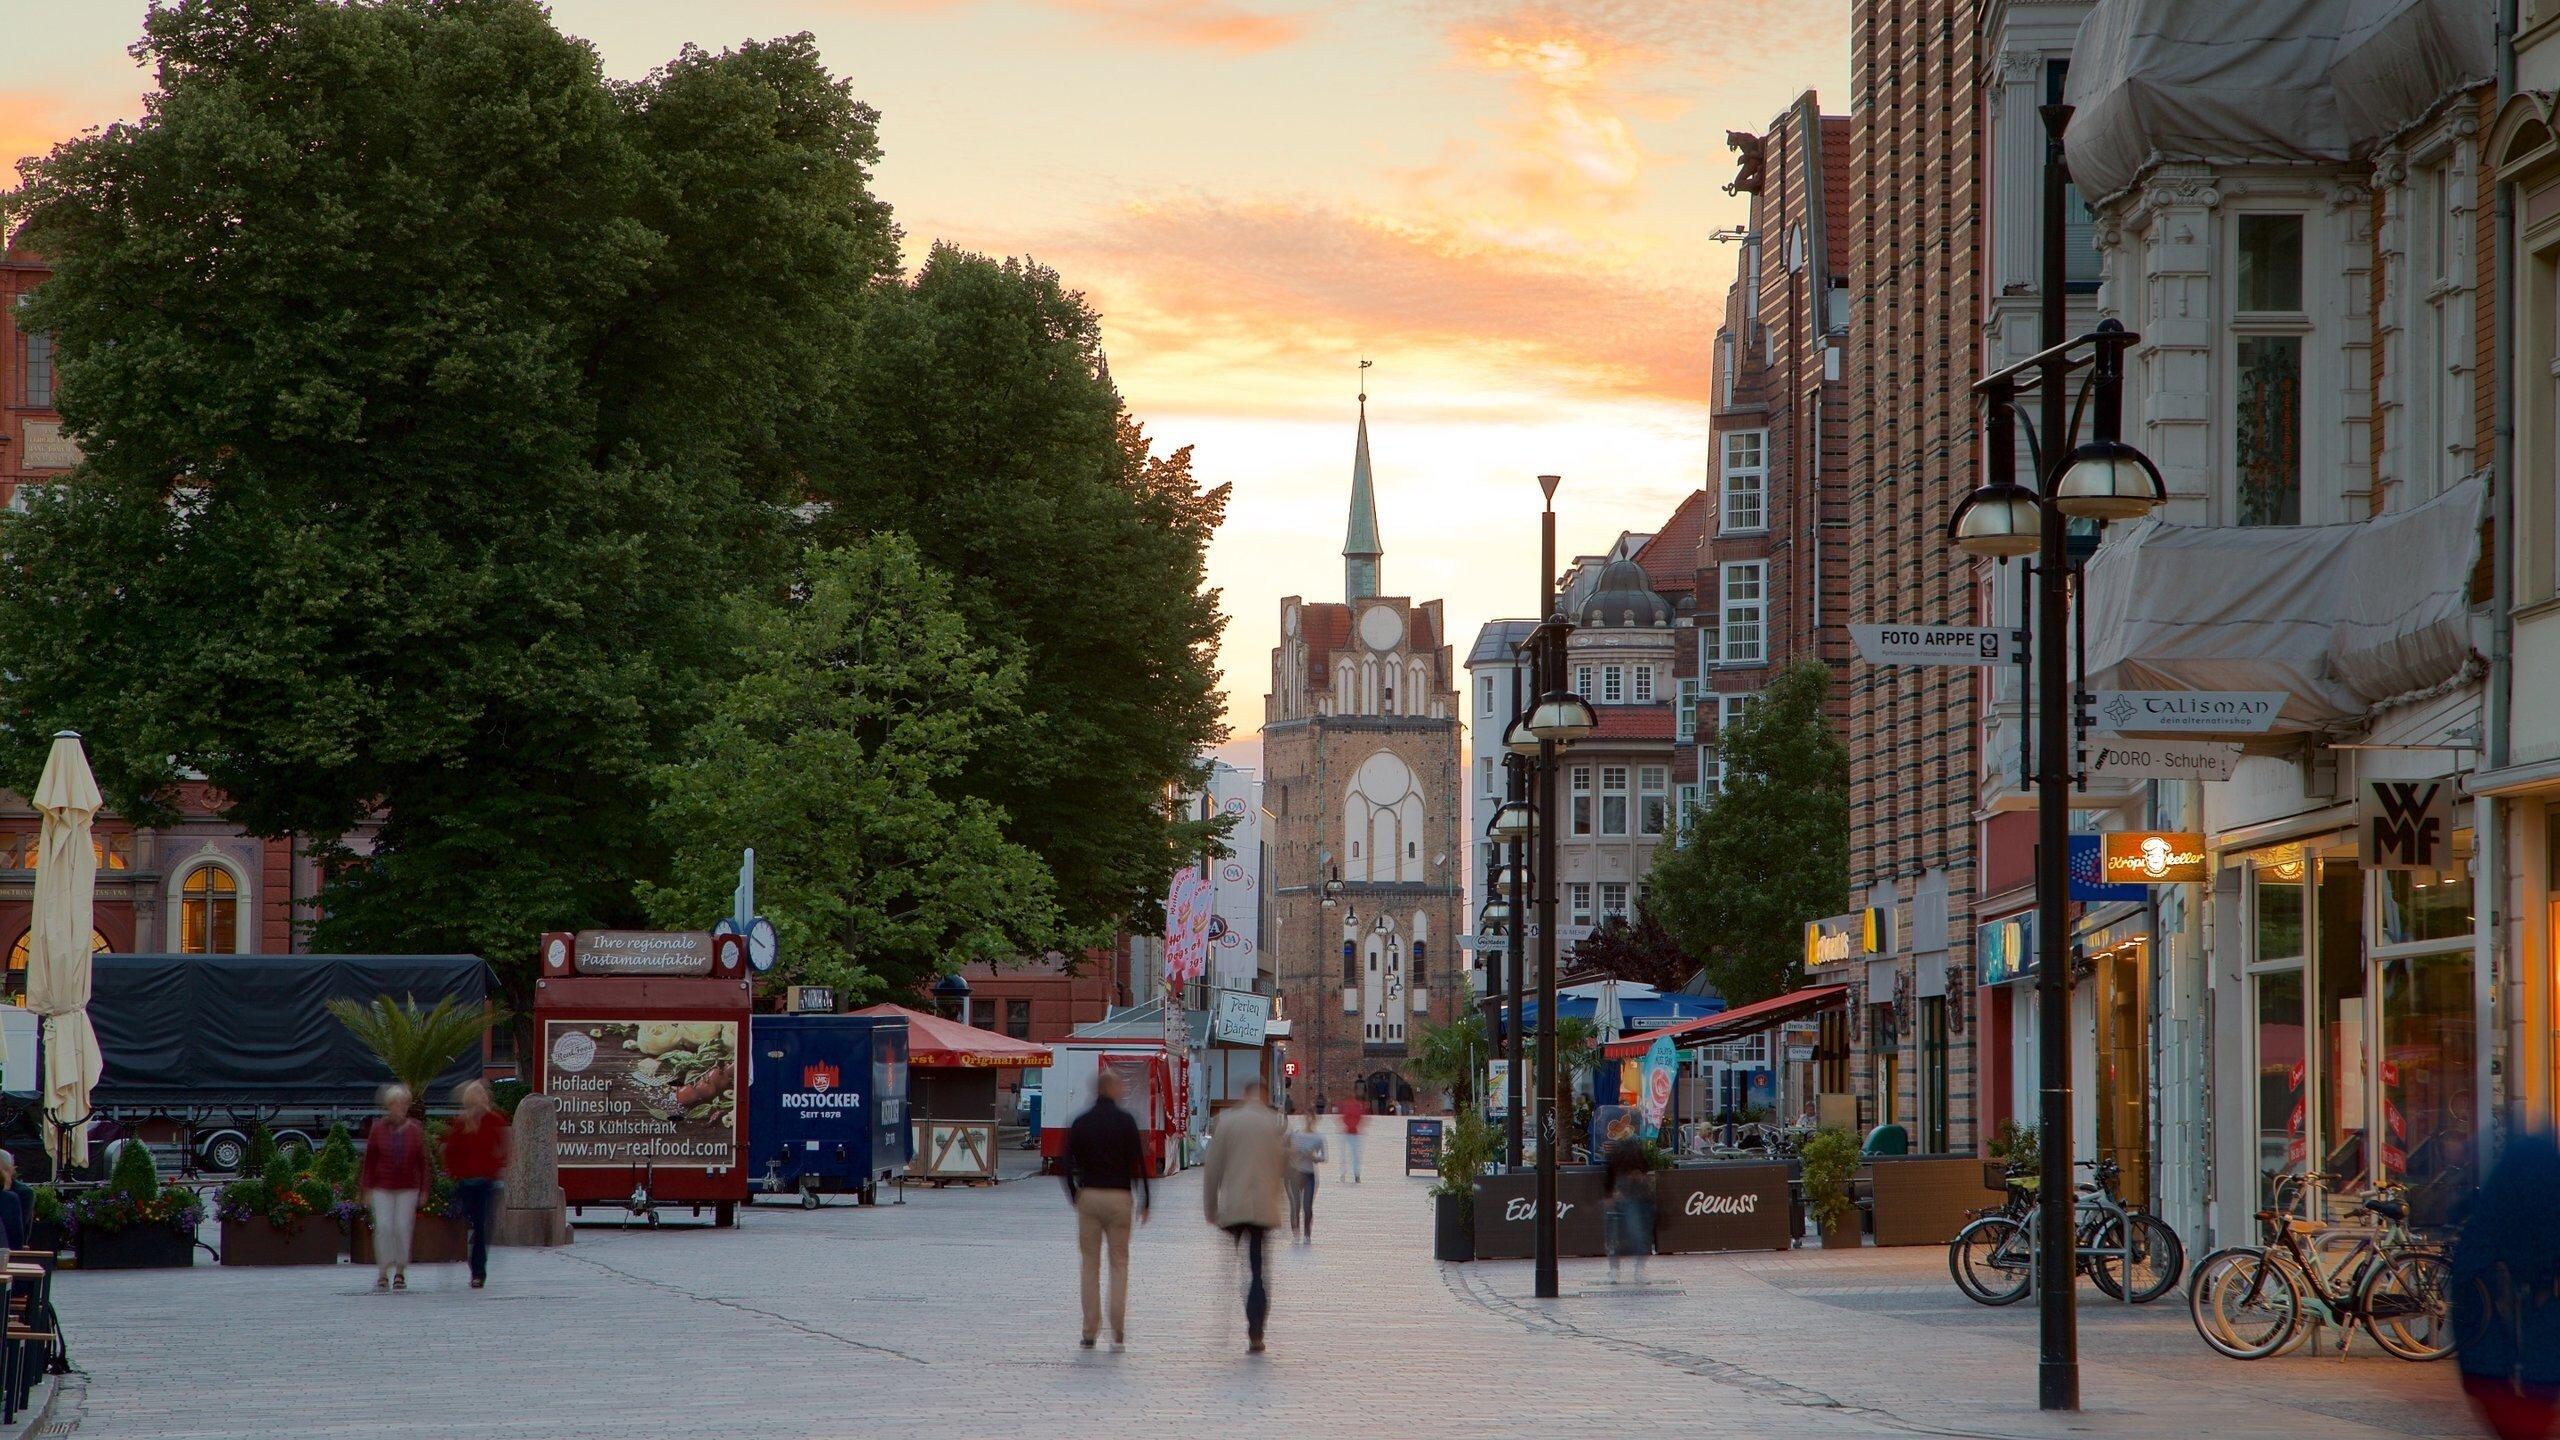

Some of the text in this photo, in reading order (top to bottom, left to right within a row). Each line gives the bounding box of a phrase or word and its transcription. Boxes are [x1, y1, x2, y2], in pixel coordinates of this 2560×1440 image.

[1881, 631, 1975, 646] FOTO ARPPE
[2109, 750, 2151, 766] DORO
[2164, 752, 2216, 769] Schuhe
[593, 935, 697, 953] Ihre regionale
[1168, 929, 1186, 946] Hot
[582, 952, 706, 968] Pastamanufaktur
[1167, 947, 1188, 963] Dogs
[1230, 996, 1260, 1017] Perlen
[908, 1054, 935, 1064] rst
[961, 1054, 1014, 1067] Original
[554, 1096, 632, 1115] Onlineshop
[782, 1093, 860, 1108] ROSTOCKER
[820, 1111, 841, 1119] 1878
[556, 1119, 677, 1134] 4h SB Kühlschrank
[556, 1138, 728, 1159] www.my-realfood.com
[1684, 1190, 1758, 1216] Genuss
